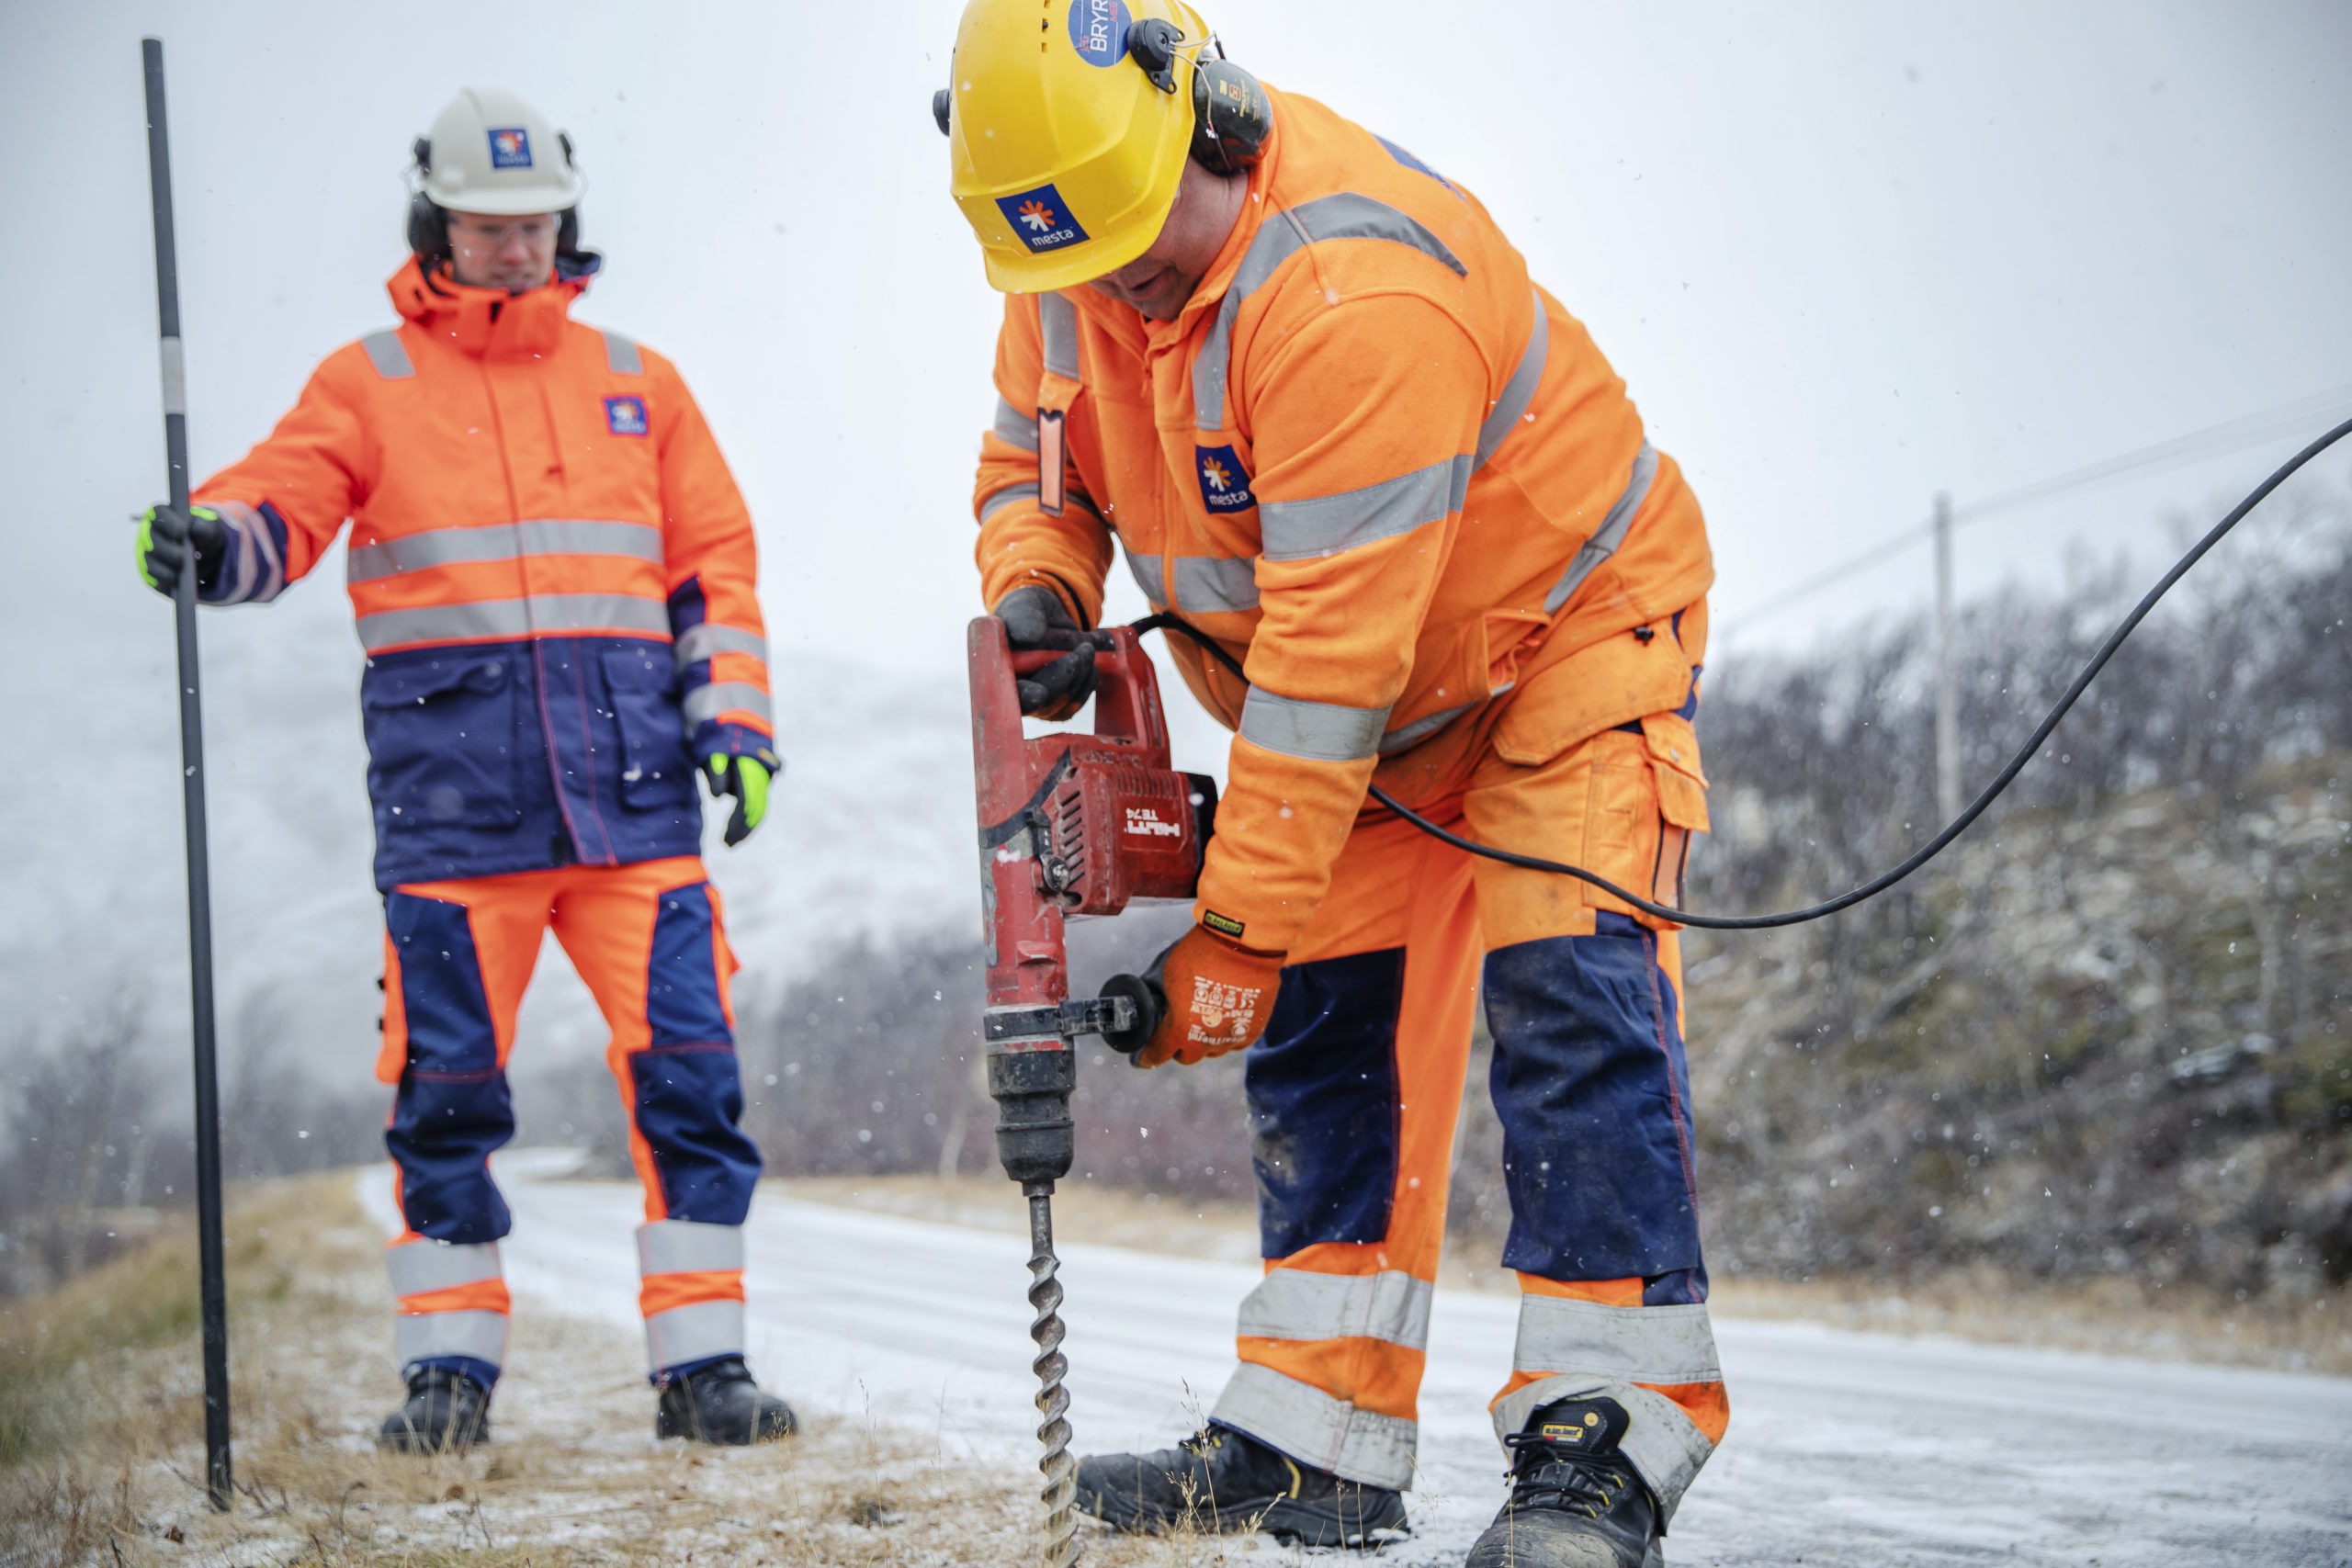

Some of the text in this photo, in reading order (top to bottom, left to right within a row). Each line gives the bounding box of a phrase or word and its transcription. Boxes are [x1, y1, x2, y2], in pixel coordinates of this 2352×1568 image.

[1109, 1, 1118, 22] MEG
[1090, 0, 1109, 52] BRYR
[1032, 229, 1074, 246] mesta
[1208, 490, 1249, 506] mesta
[1127, 820, 1181, 837] HILTI
